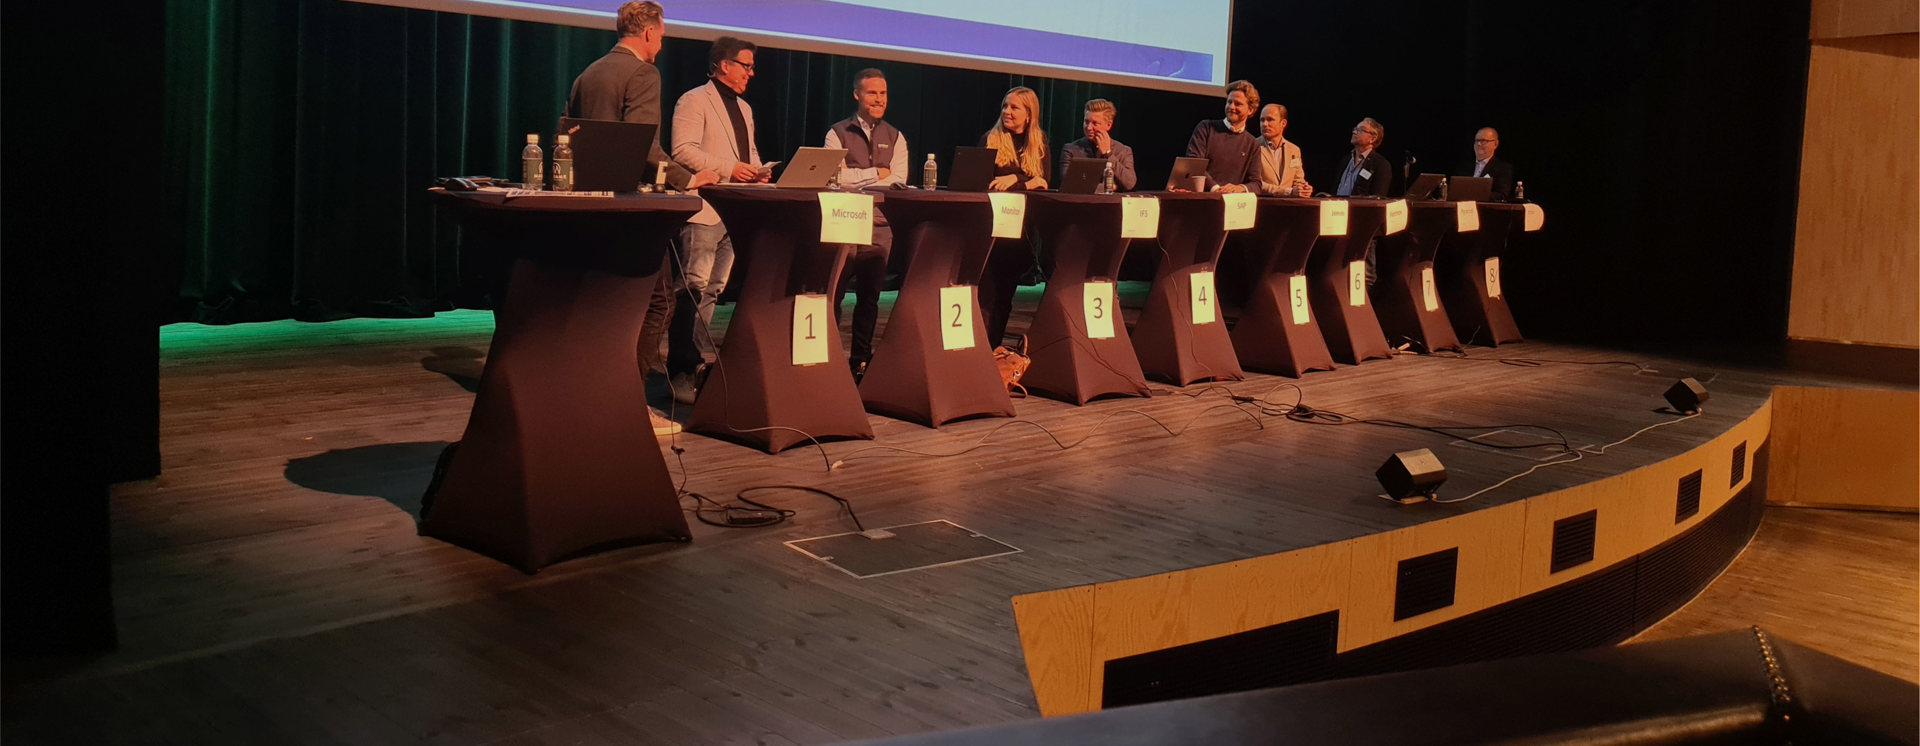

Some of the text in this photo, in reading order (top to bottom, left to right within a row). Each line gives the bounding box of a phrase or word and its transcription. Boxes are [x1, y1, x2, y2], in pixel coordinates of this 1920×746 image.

[832, 208, 867, 220] Microsoft
[1354, 273, 1361, 290] 6
[1489, 267, 1496, 283] 8
[1198, 285, 1207, 306] 4
[1425, 280, 1431, 296] 7
[1296, 289, 1303, 307] 5
[951, 303, 962, 327] 2
[1093, 297, 1103, 319] 3
[804, 313, 816, 340] 1
